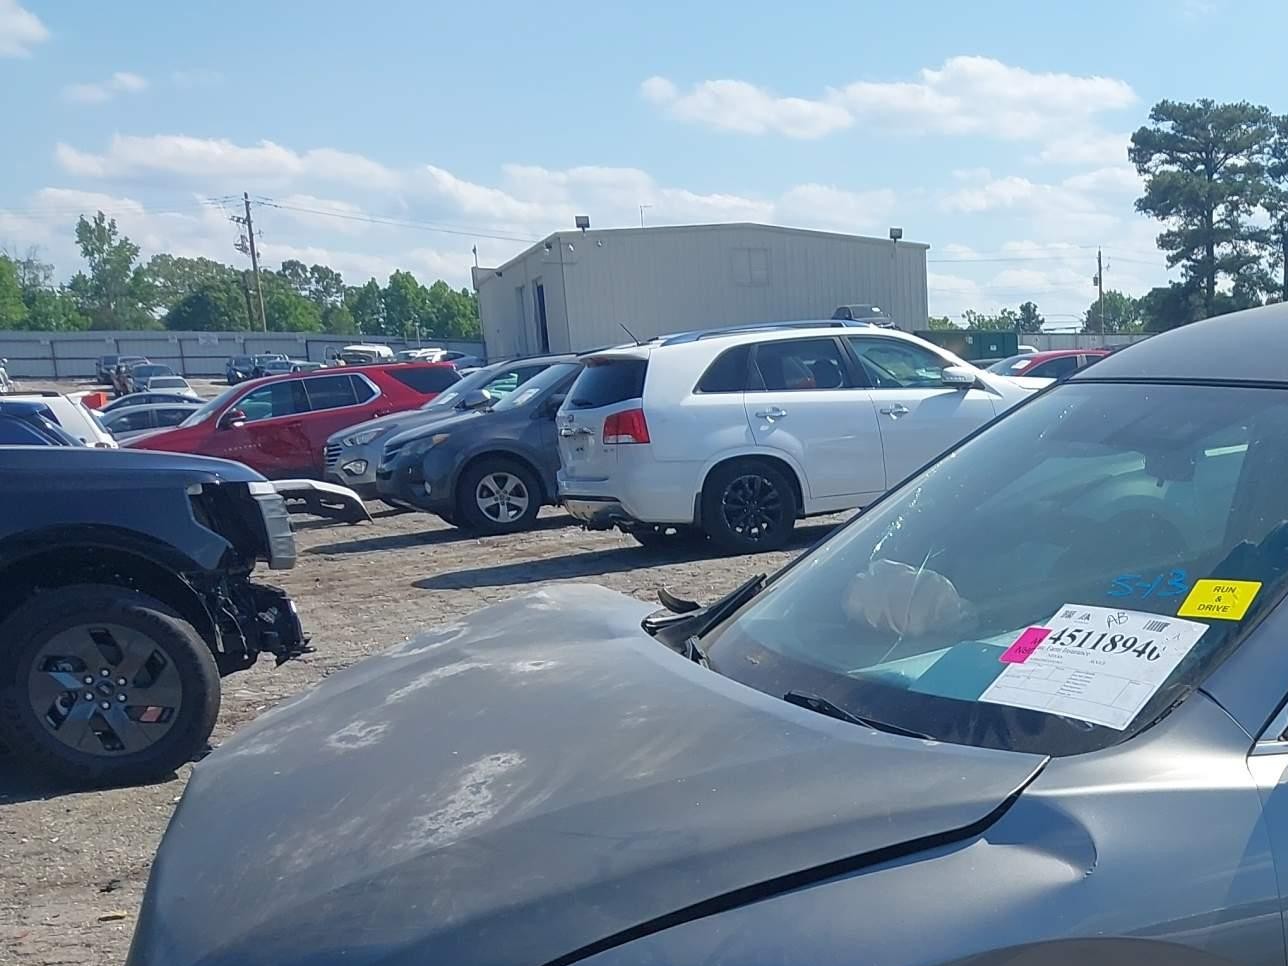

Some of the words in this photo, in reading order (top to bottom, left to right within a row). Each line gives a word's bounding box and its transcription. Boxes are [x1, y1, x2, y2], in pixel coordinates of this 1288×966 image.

[1212, 585, 1237, 594] RUN
[1214, 595, 1223, 603] &
[1197, 603, 1231, 613] DRIVE
